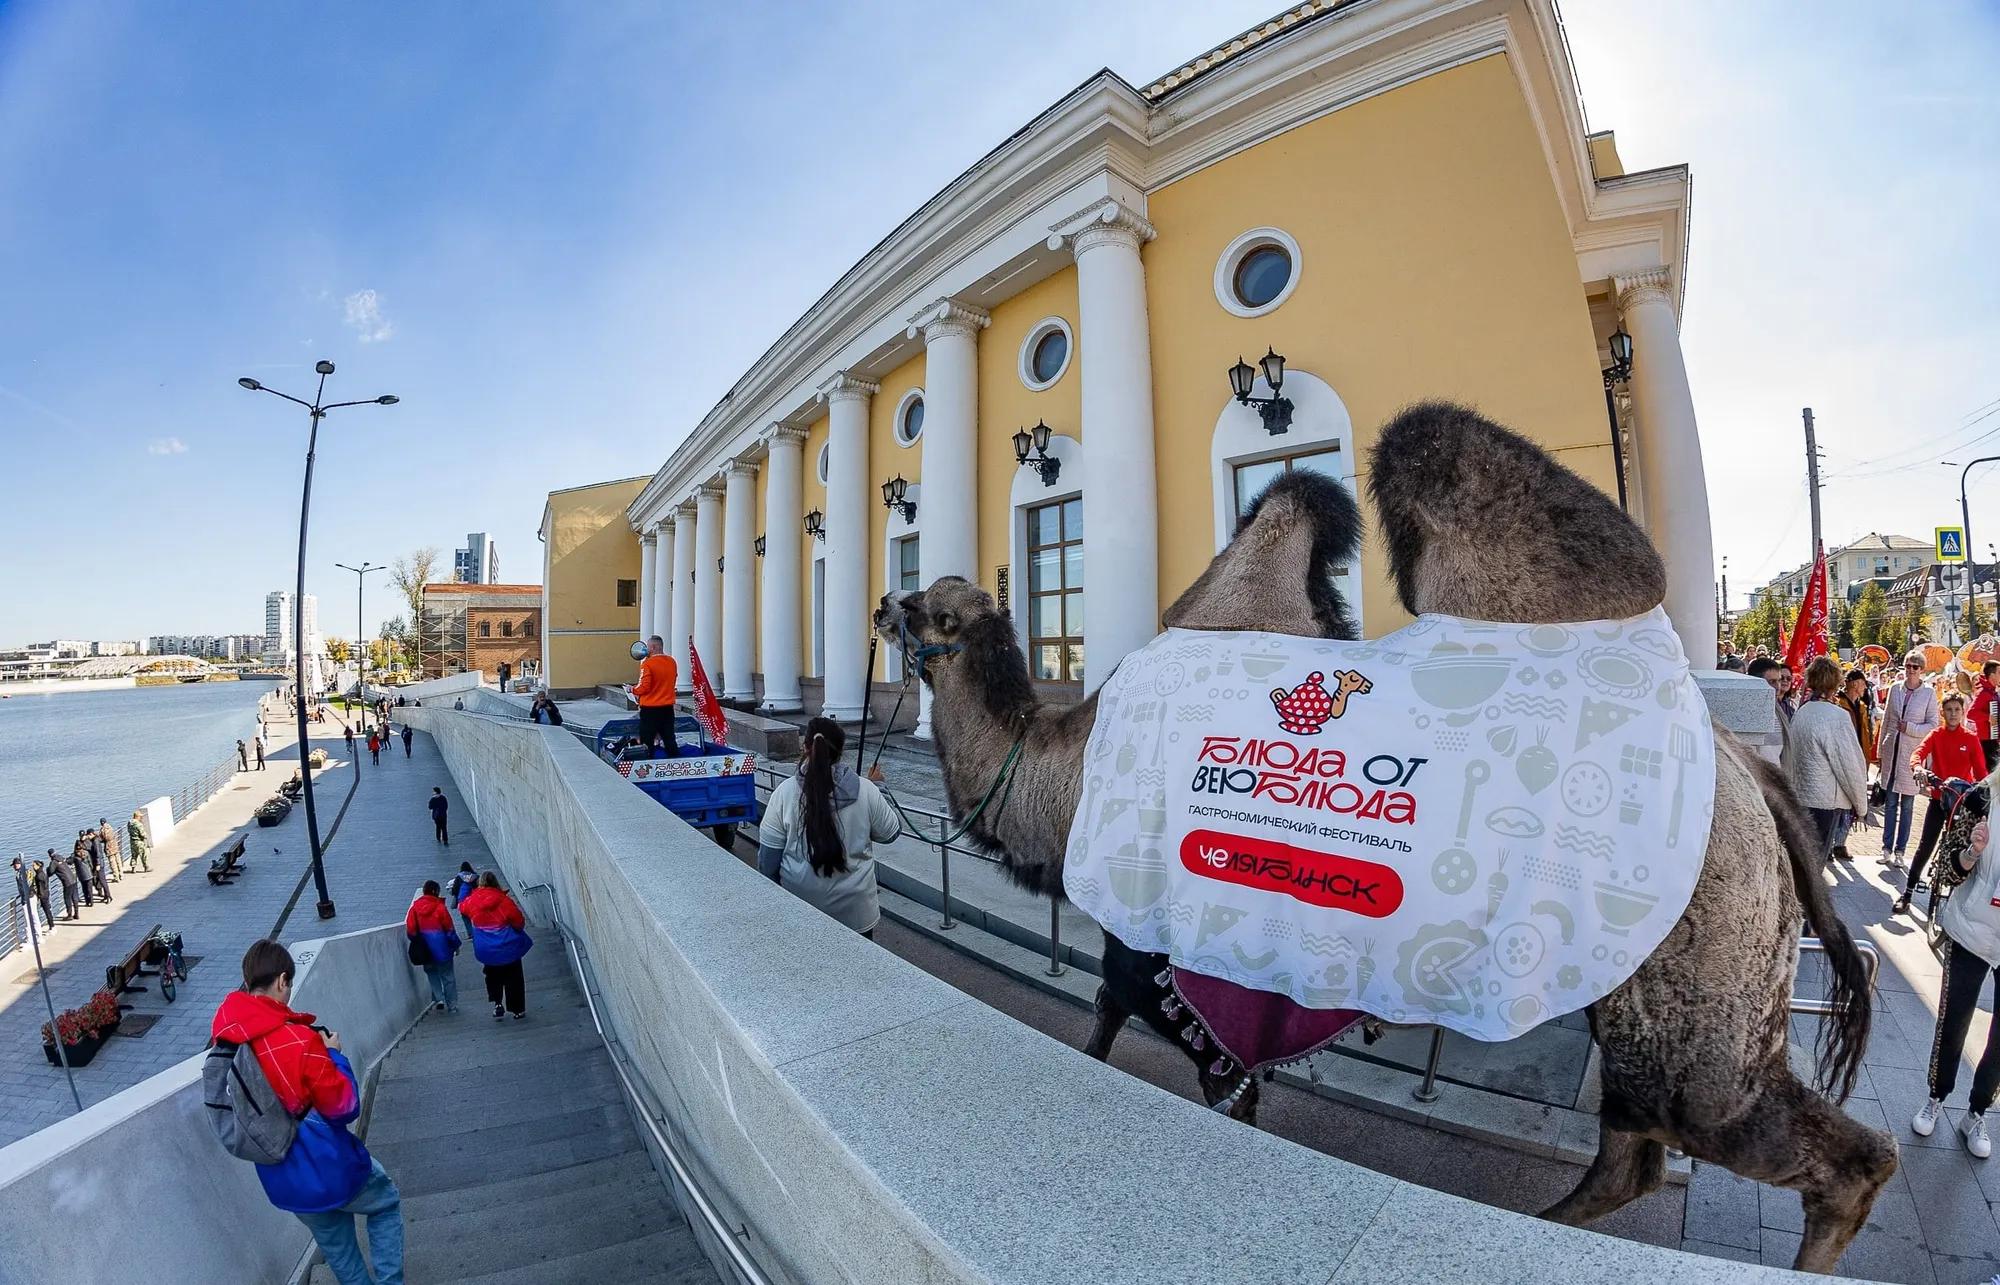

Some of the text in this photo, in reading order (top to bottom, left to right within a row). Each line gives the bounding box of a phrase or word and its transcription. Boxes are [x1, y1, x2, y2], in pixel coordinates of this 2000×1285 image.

[1362, 754, 1429, 788] ОТ
[1188, 804, 1413, 854] ГАСТРОНОМИЧЕСКИЙ ФЕСТИВАЛЬ
